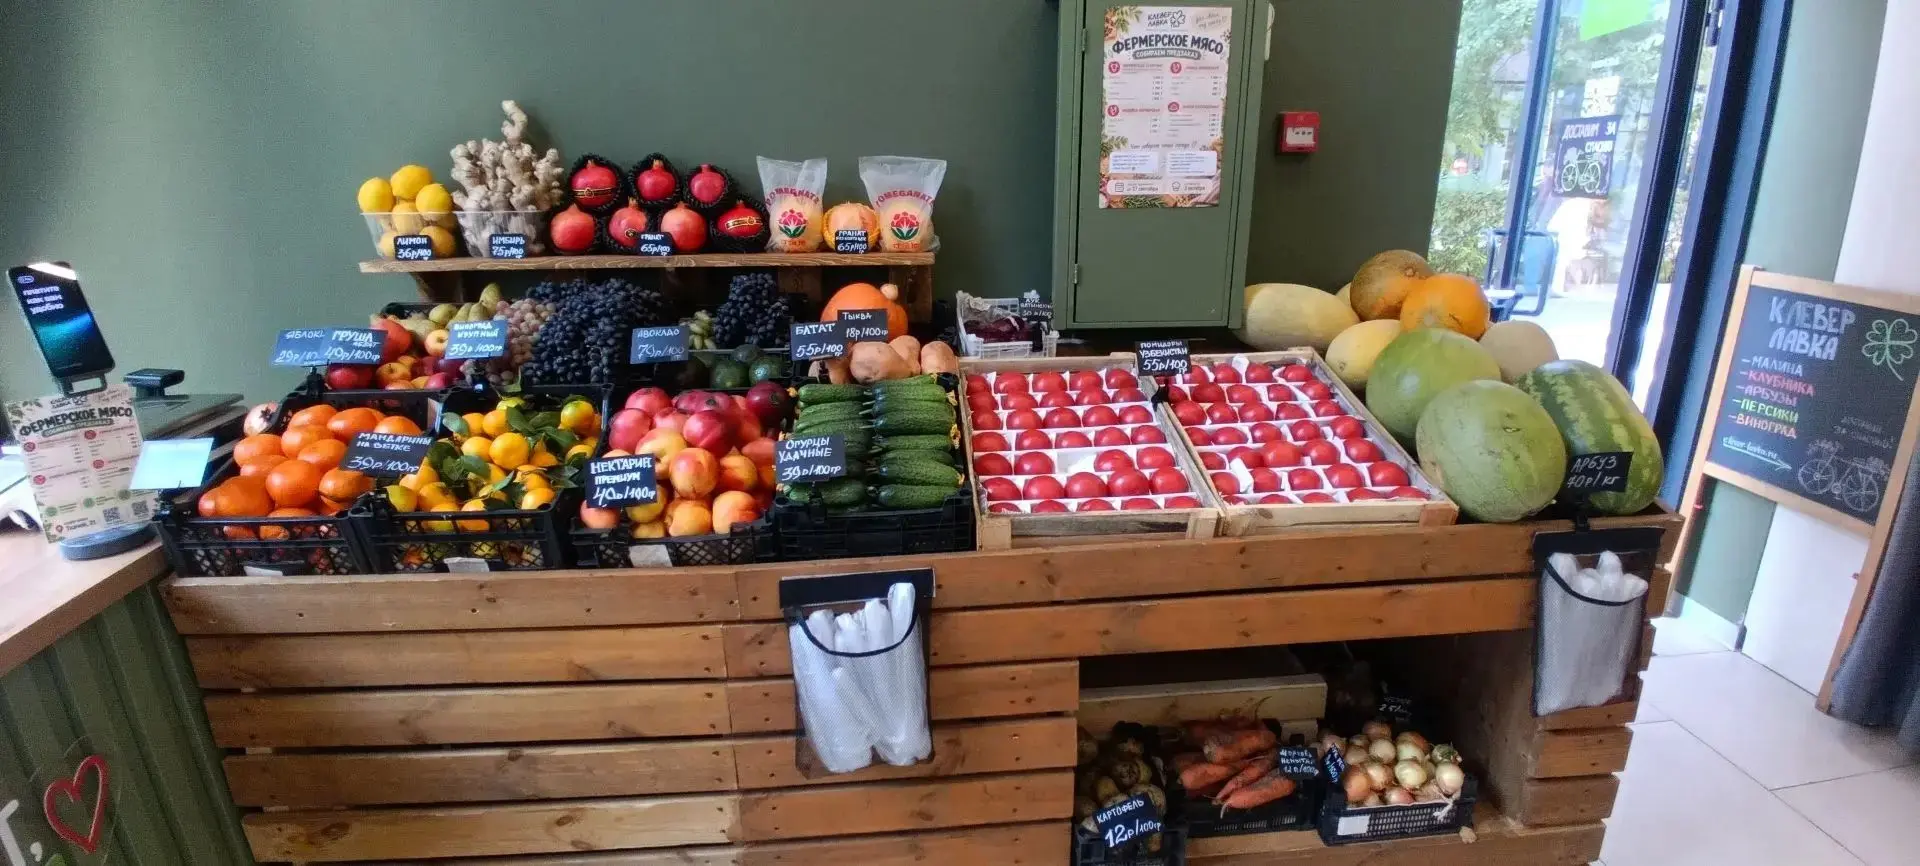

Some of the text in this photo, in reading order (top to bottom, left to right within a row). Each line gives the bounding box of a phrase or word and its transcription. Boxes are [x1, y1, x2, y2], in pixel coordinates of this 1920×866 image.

[1147, 19, 1168, 27] ЛАВКА
[1112, 33, 1224, 54] ФЕРМЕРСКОЕ МЯСО
[1562, 121, 1616, 140] ДОСТАВИМ ЗА
[396, 237, 427, 245] ЛИМОН
[492, 236, 525, 244] ИМБИРЬ
[27, 297, 44, 305] как
[30, 303, 64, 315] удобно
[1768, 296, 1856, 335] КЛЕВЕР
[331, 329, 373, 342] ГРУША
[637, 328, 680, 338] АВОКАДО
[795, 323, 836, 335] БАТАТ
[1768, 326, 1838, 361] ЛАВКА
[19, 408, 97, 437] ФЕРМЕРСКОЕ
[98, 406, 133, 418] МЯСО
[358, 432, 432, 446] МАНДАРИНЫ
[786, 437, 830, 450] ОГУРЦЫ
[373, 443, 411, 452] ВЕТКЕ
[778, 447, 832, 463] УДАЧНЫЕ
[590, 457, 652, 475] НЕКТАРИН
[1570, 455, 1617, 473] АРБУЗ
[594, 471, 641, 485] ПРЕМИУМ
[1096, 799, 1144, 824] КАРТОФЕЛЬ
